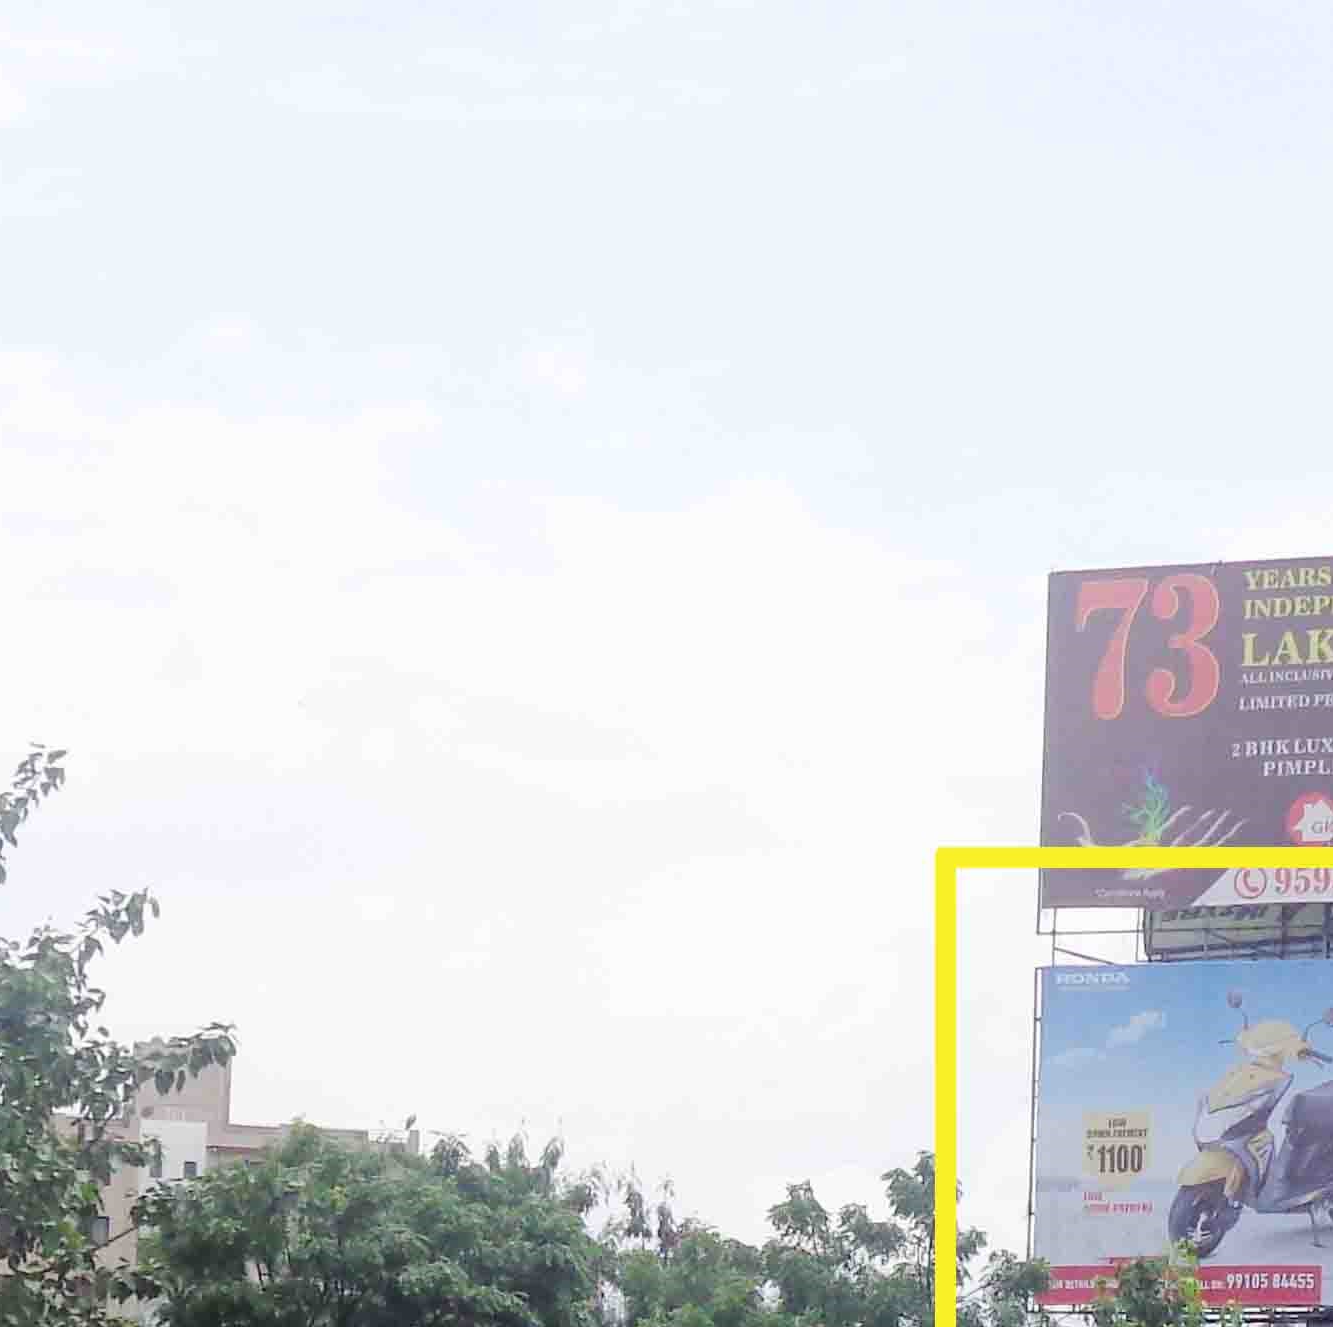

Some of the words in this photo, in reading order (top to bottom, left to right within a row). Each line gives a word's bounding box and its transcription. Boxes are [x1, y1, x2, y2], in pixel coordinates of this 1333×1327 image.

[1243, 567, 1332, 591] YEARS
[1074, 573, 1221, 720] 73
[1240, 671, 1267, 685] ALL
[1239, 693, 1310, 711] LIMITED
[1231, 743, 1241, 758] 2
[1245, 739, 1292, 757] BHK
[1226, 1273, 1268, 1289] 99105
